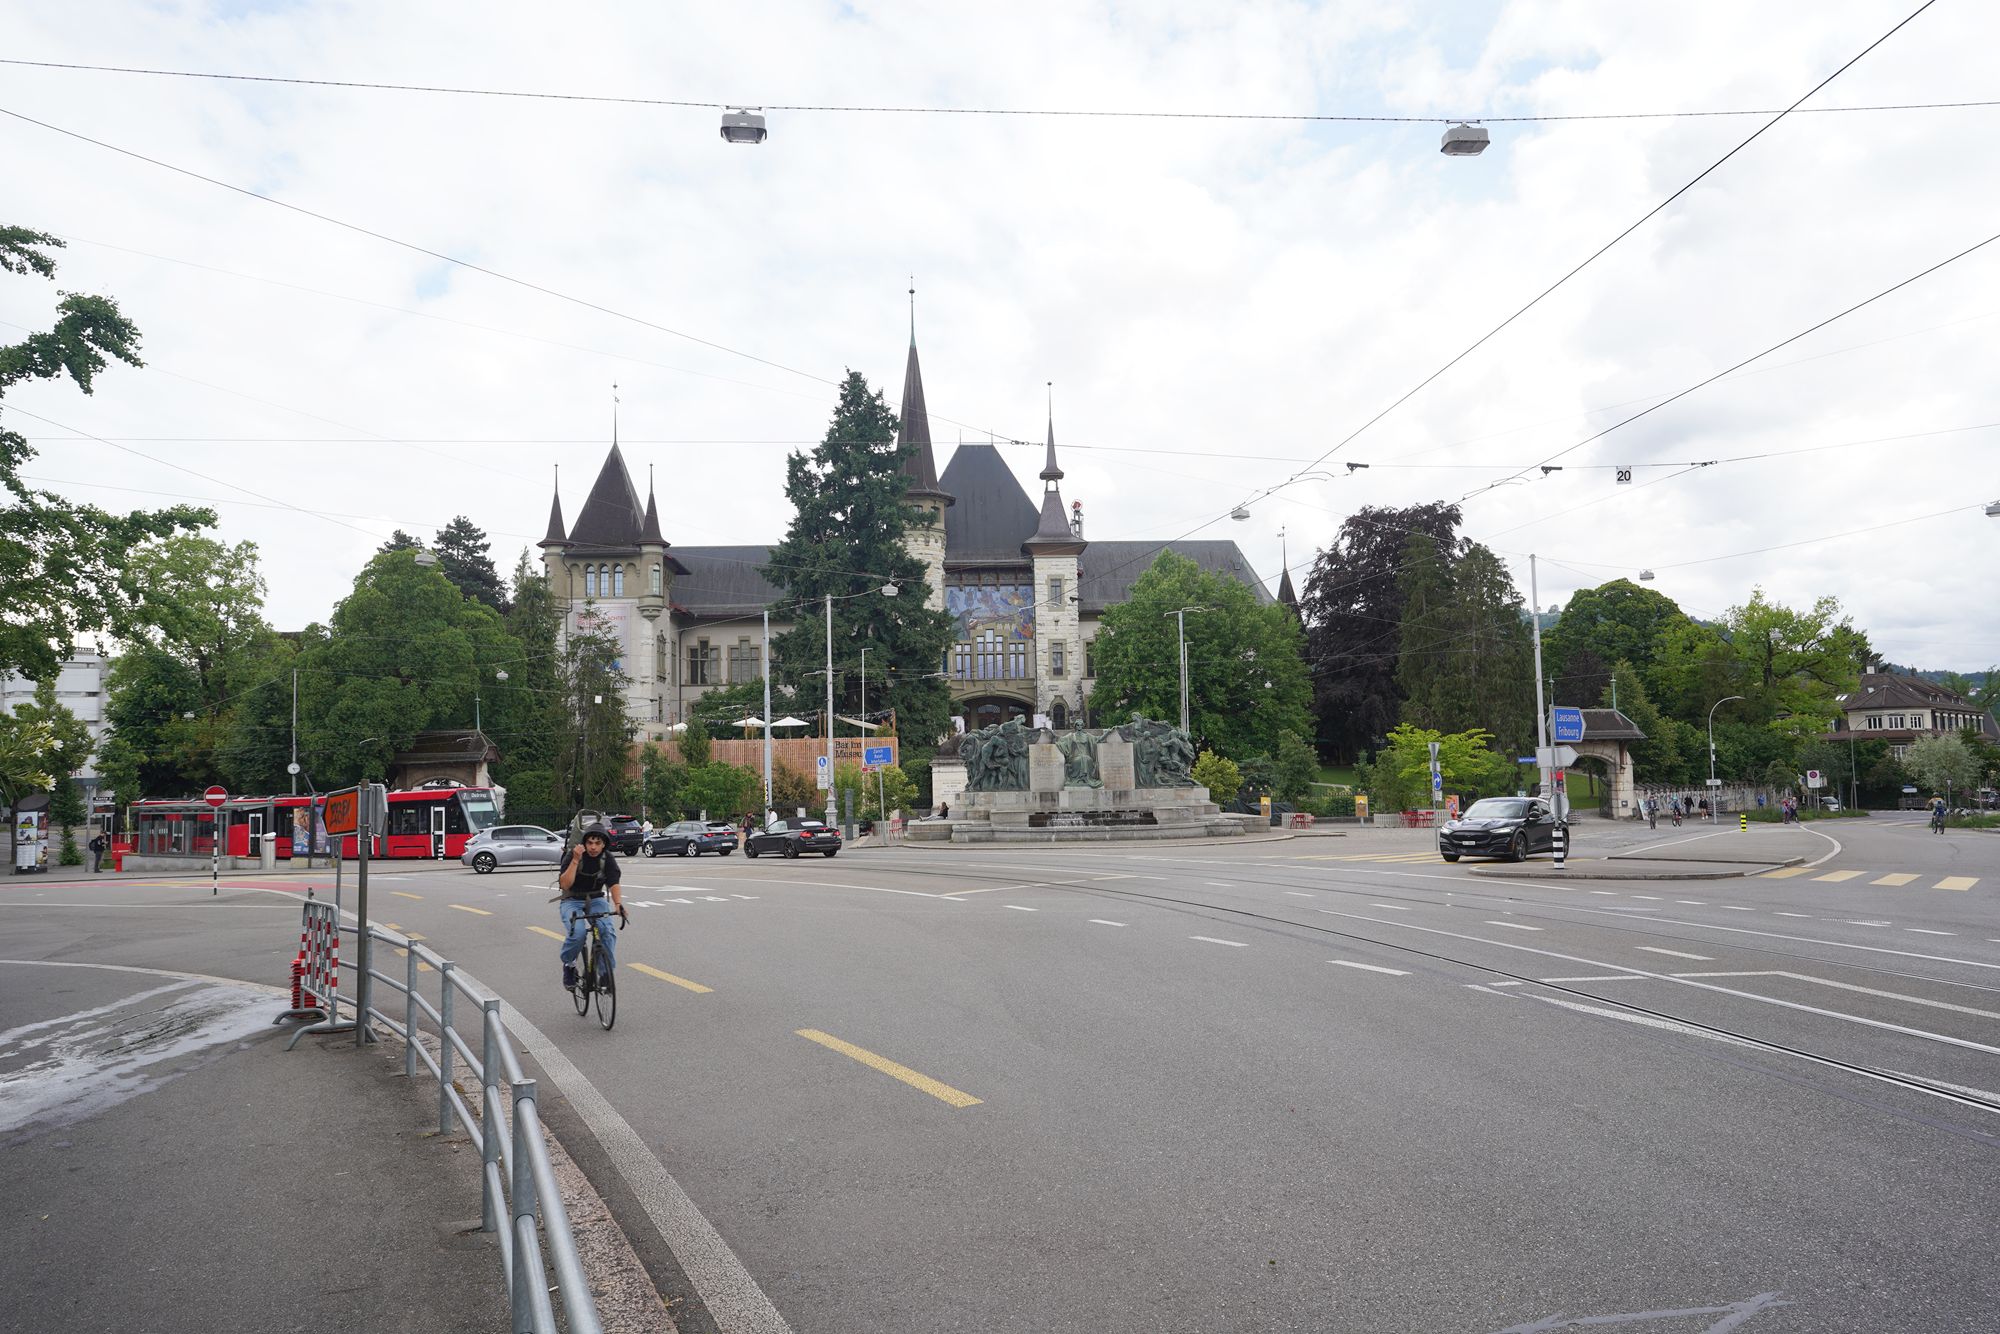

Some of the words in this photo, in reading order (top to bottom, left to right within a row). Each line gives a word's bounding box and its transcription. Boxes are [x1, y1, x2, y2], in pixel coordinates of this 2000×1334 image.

[1617, 470, 1631, 481] 20
[1556, 711, 1580, 723] Lausanne
[1558, 726, 1579, 739] Fribourg
[835, 741, 848, 749] Bar
[835, 749, 863, 758] Museu
[626, 894, 760, 907] TRAM
